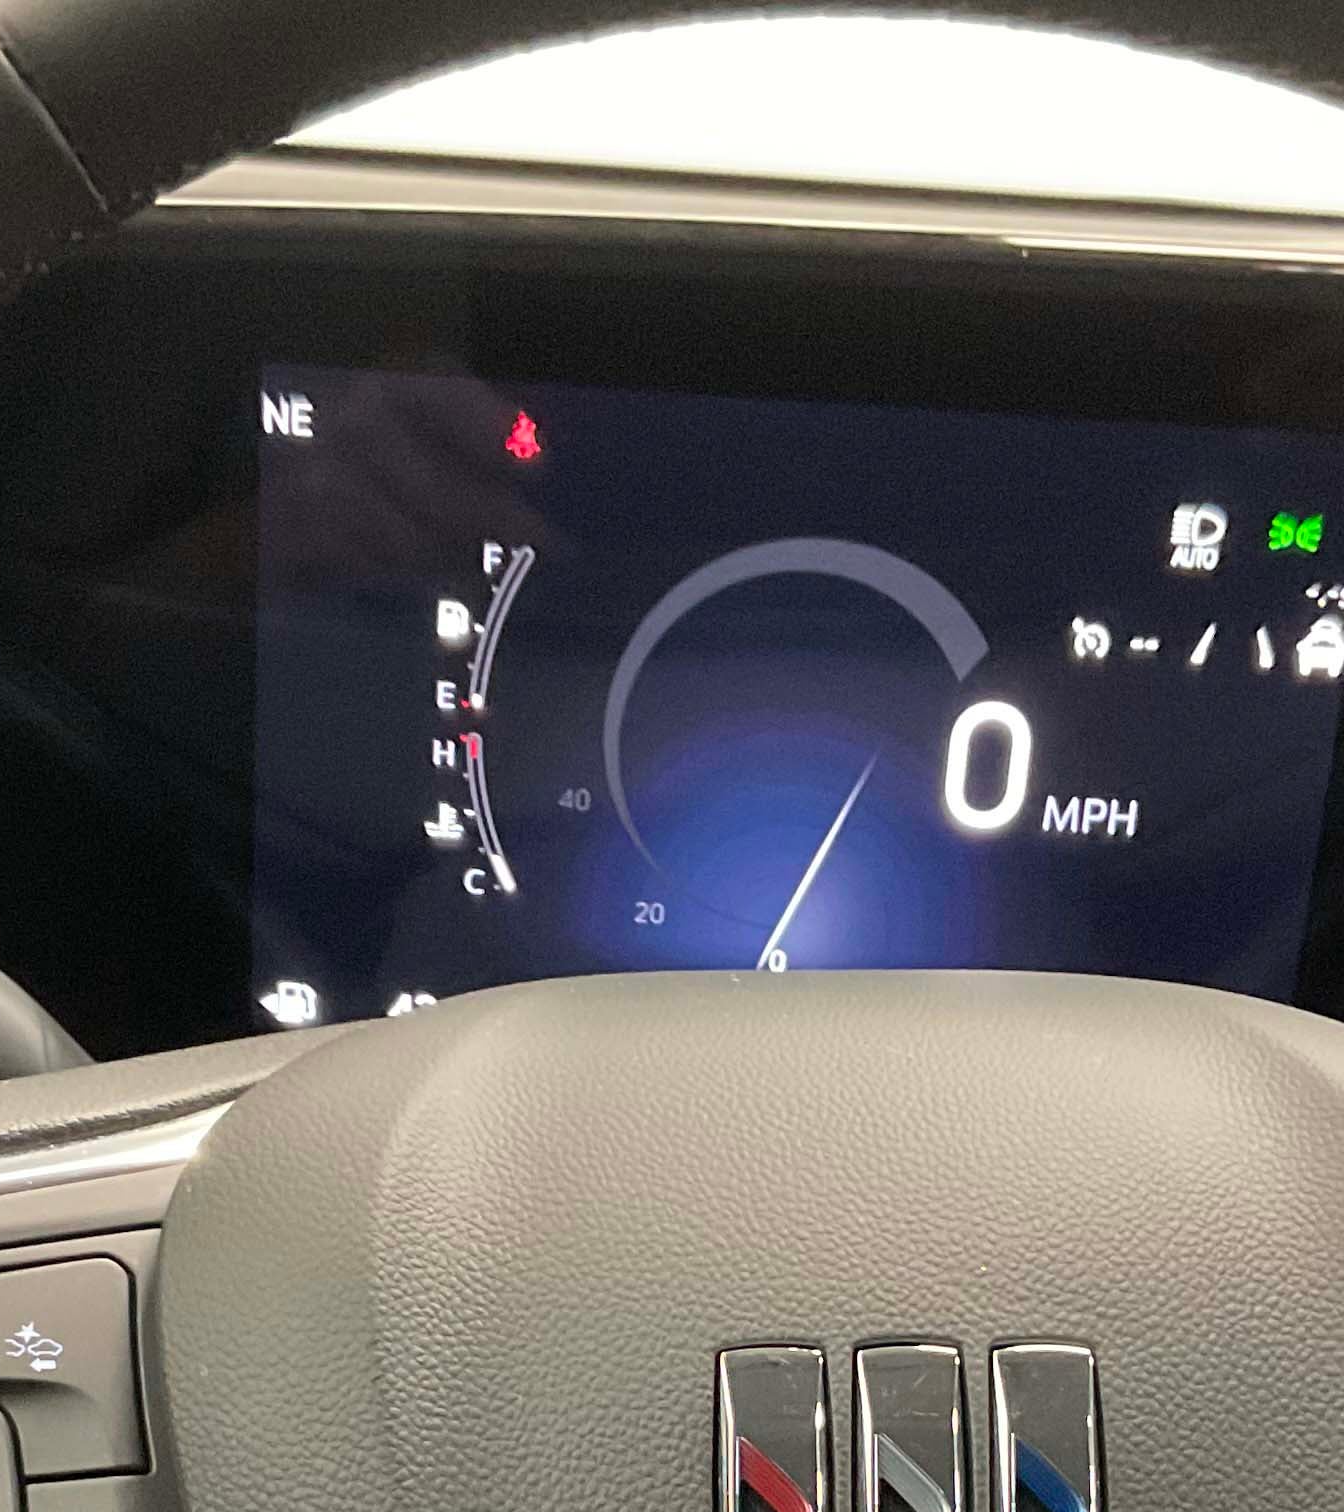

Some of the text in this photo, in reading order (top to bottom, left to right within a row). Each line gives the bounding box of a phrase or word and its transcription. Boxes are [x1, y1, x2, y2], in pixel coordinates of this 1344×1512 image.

[261, 391, 315, 439] NE
[482, 541, 504, 575] F
[1169, 546, 1222, 571] AUTO
[435, 679, 457, 711] E
[431, 738, 457, 769] H
[944, 699, 1033, 833] 0
[557, 787, 592, 813] 40
[1040, 793, 1140, 839] MPH
[462, 867, 487, 897] C
[632, 900, 666, 927] 20
